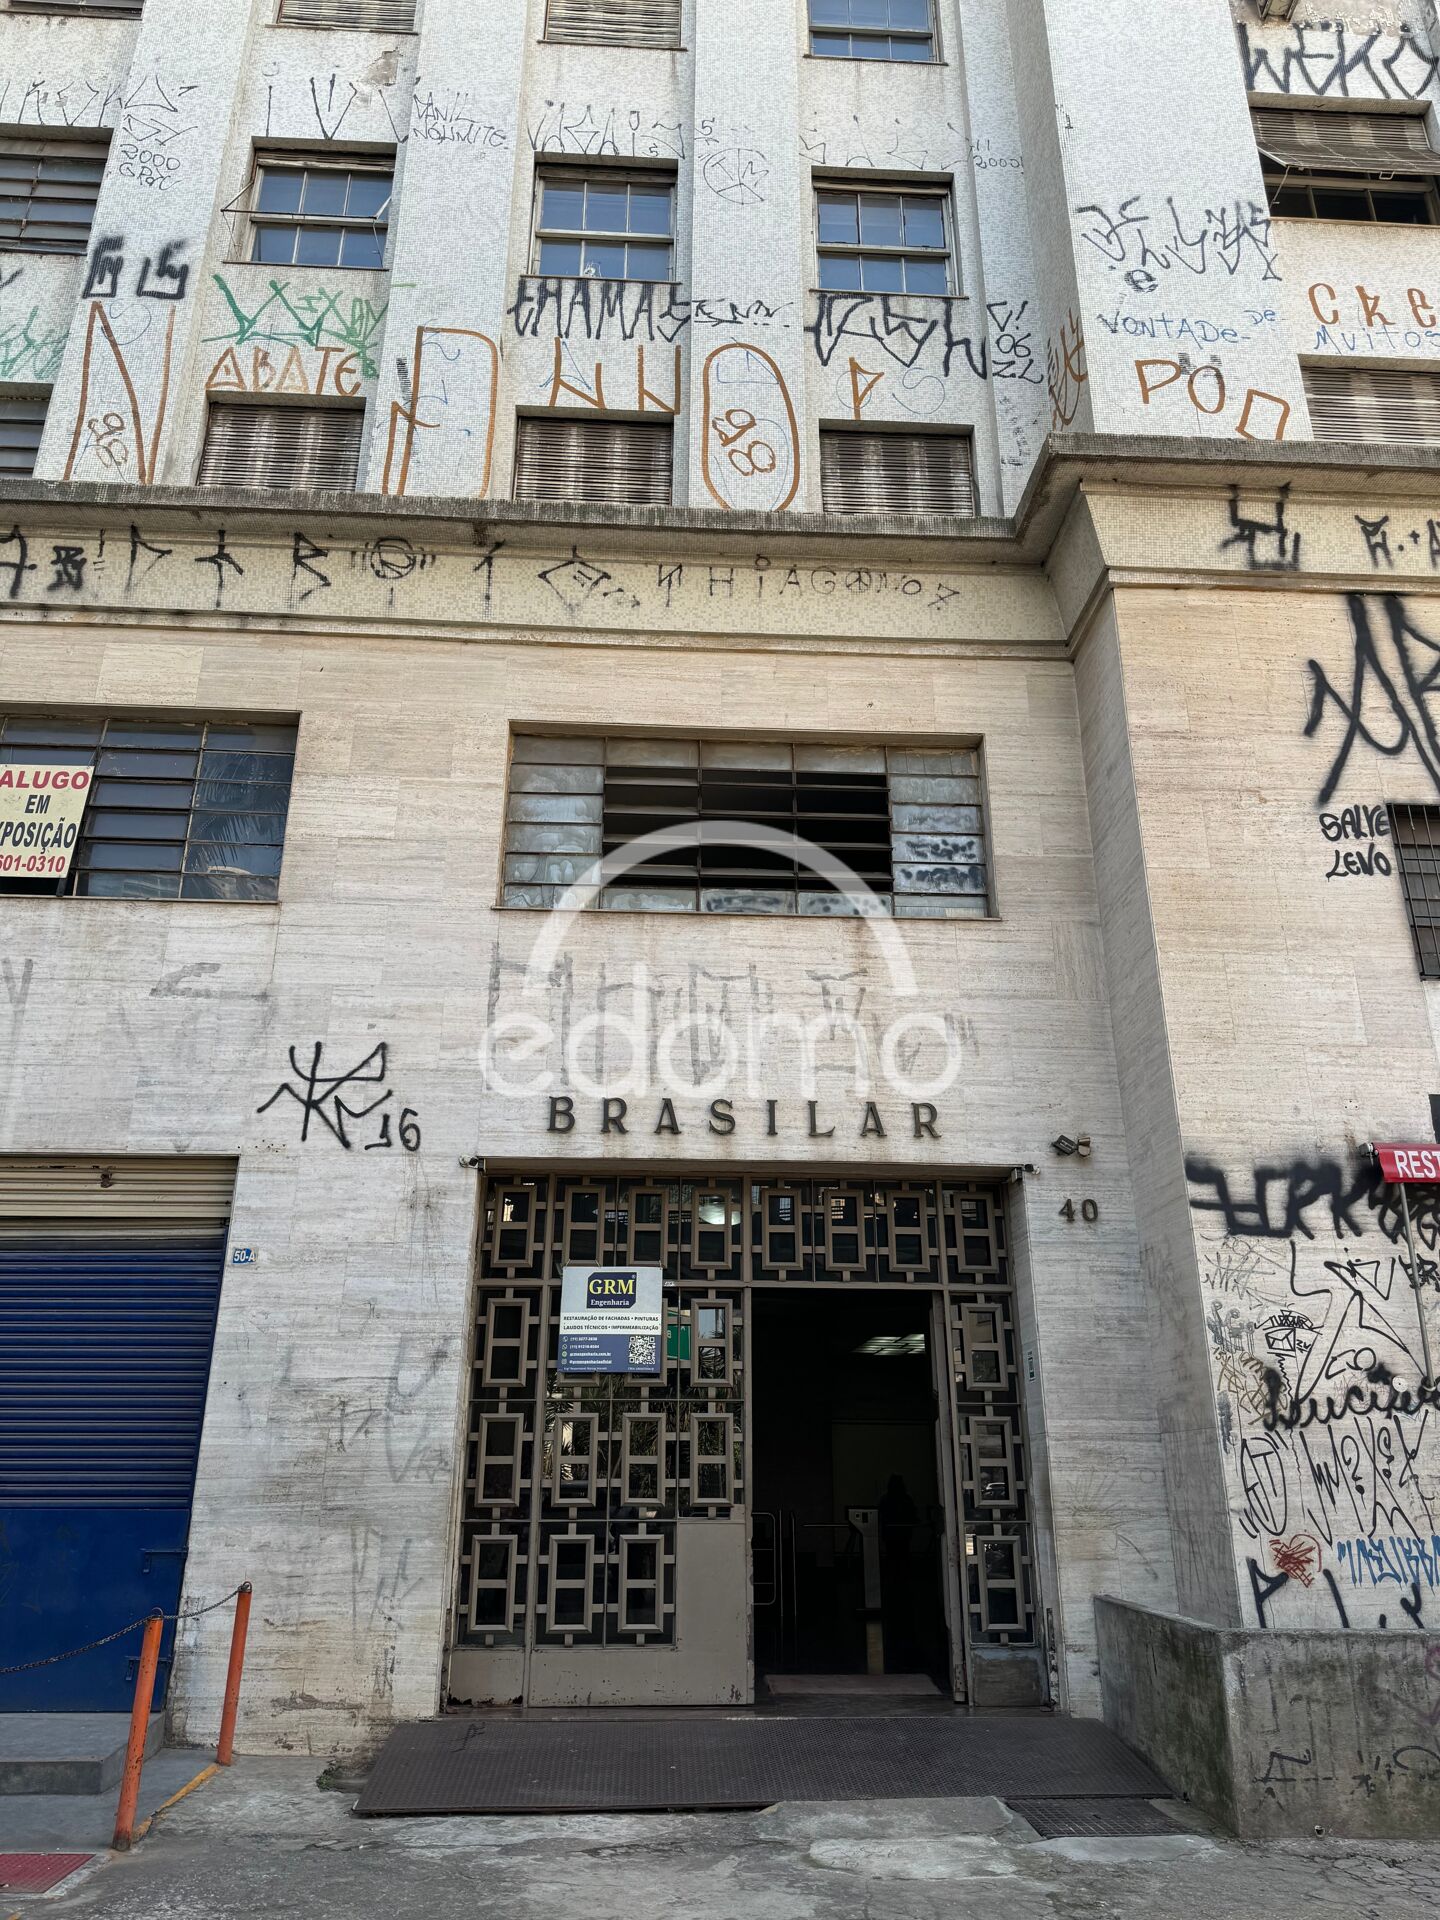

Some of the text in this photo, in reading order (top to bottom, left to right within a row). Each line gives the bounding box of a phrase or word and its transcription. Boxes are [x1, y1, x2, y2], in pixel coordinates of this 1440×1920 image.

[0, 770, 90, 790] ALUGO
[24, 795, 52, 814] EM
[0, 817, 77, 855] POSIÇÃO
[546, 1095, 943, 1138] BRASILAR
[1059, 1198, 1099, 1222] 40
[233, 1249, 257, 1262] 50-A
[589, 1279, 636, 1295] GRM
[590, 1299, 630, 1307] Engenharia
